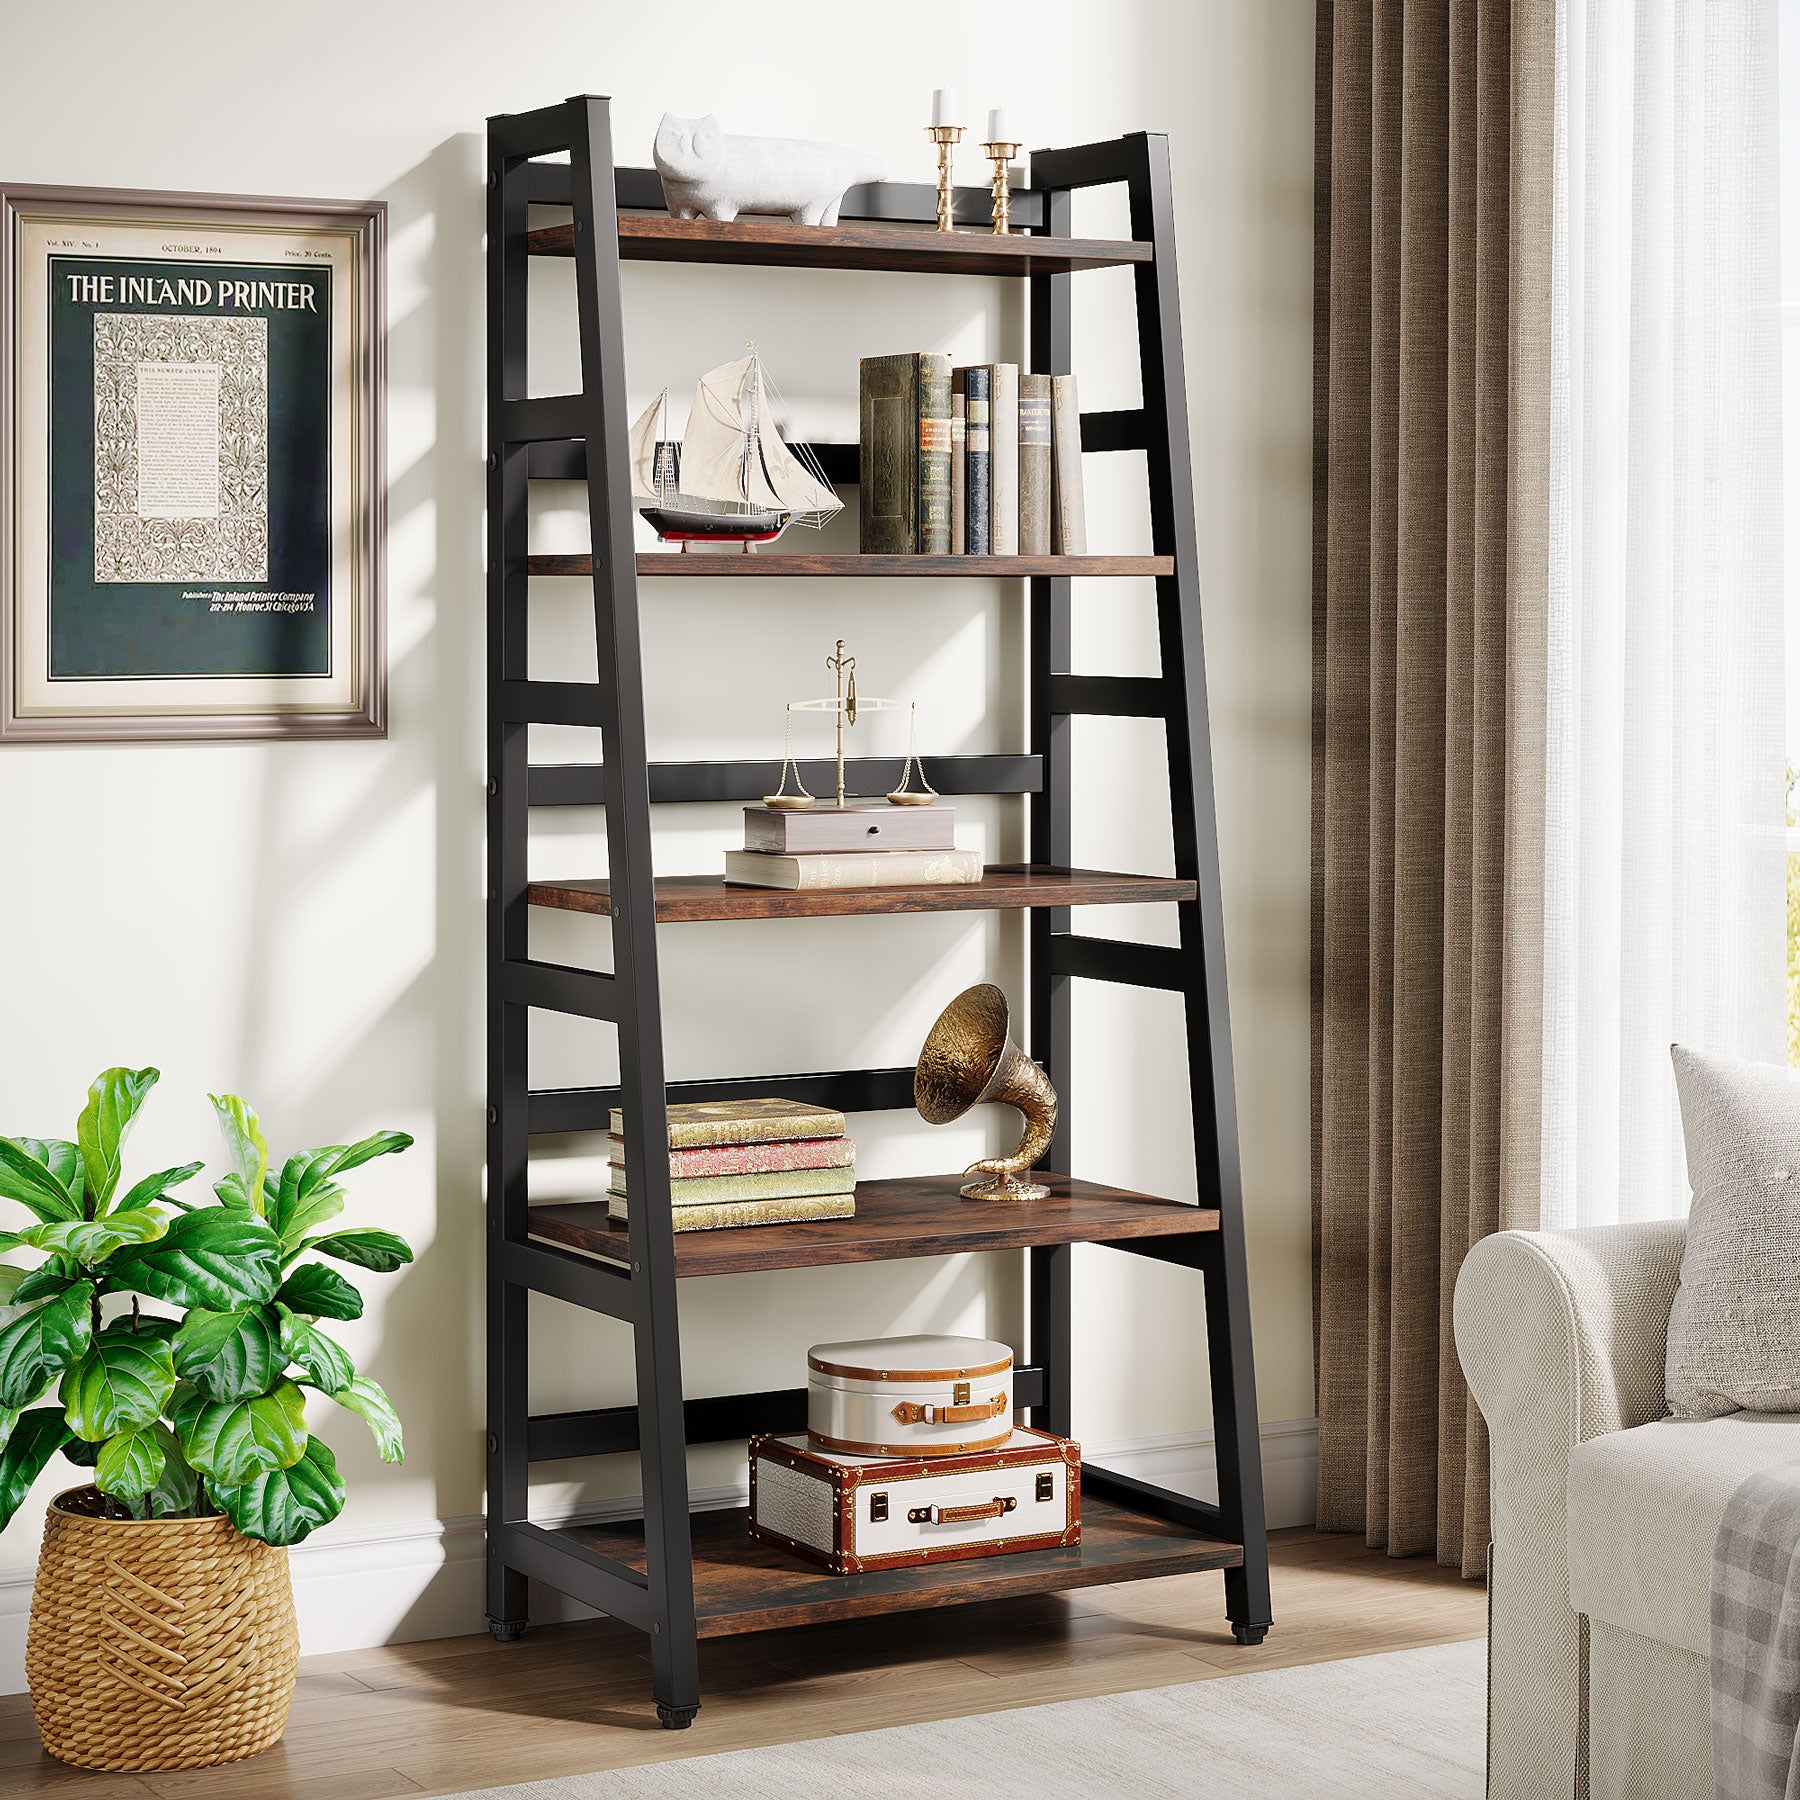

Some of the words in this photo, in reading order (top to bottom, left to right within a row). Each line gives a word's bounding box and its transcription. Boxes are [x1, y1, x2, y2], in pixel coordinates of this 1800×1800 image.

[66, 274, 114, 303] THE
[119, 276, 212, 307] INLAND
[217, 280, 318, 314] PRINTER
[278, 592, 315, 603] Company
